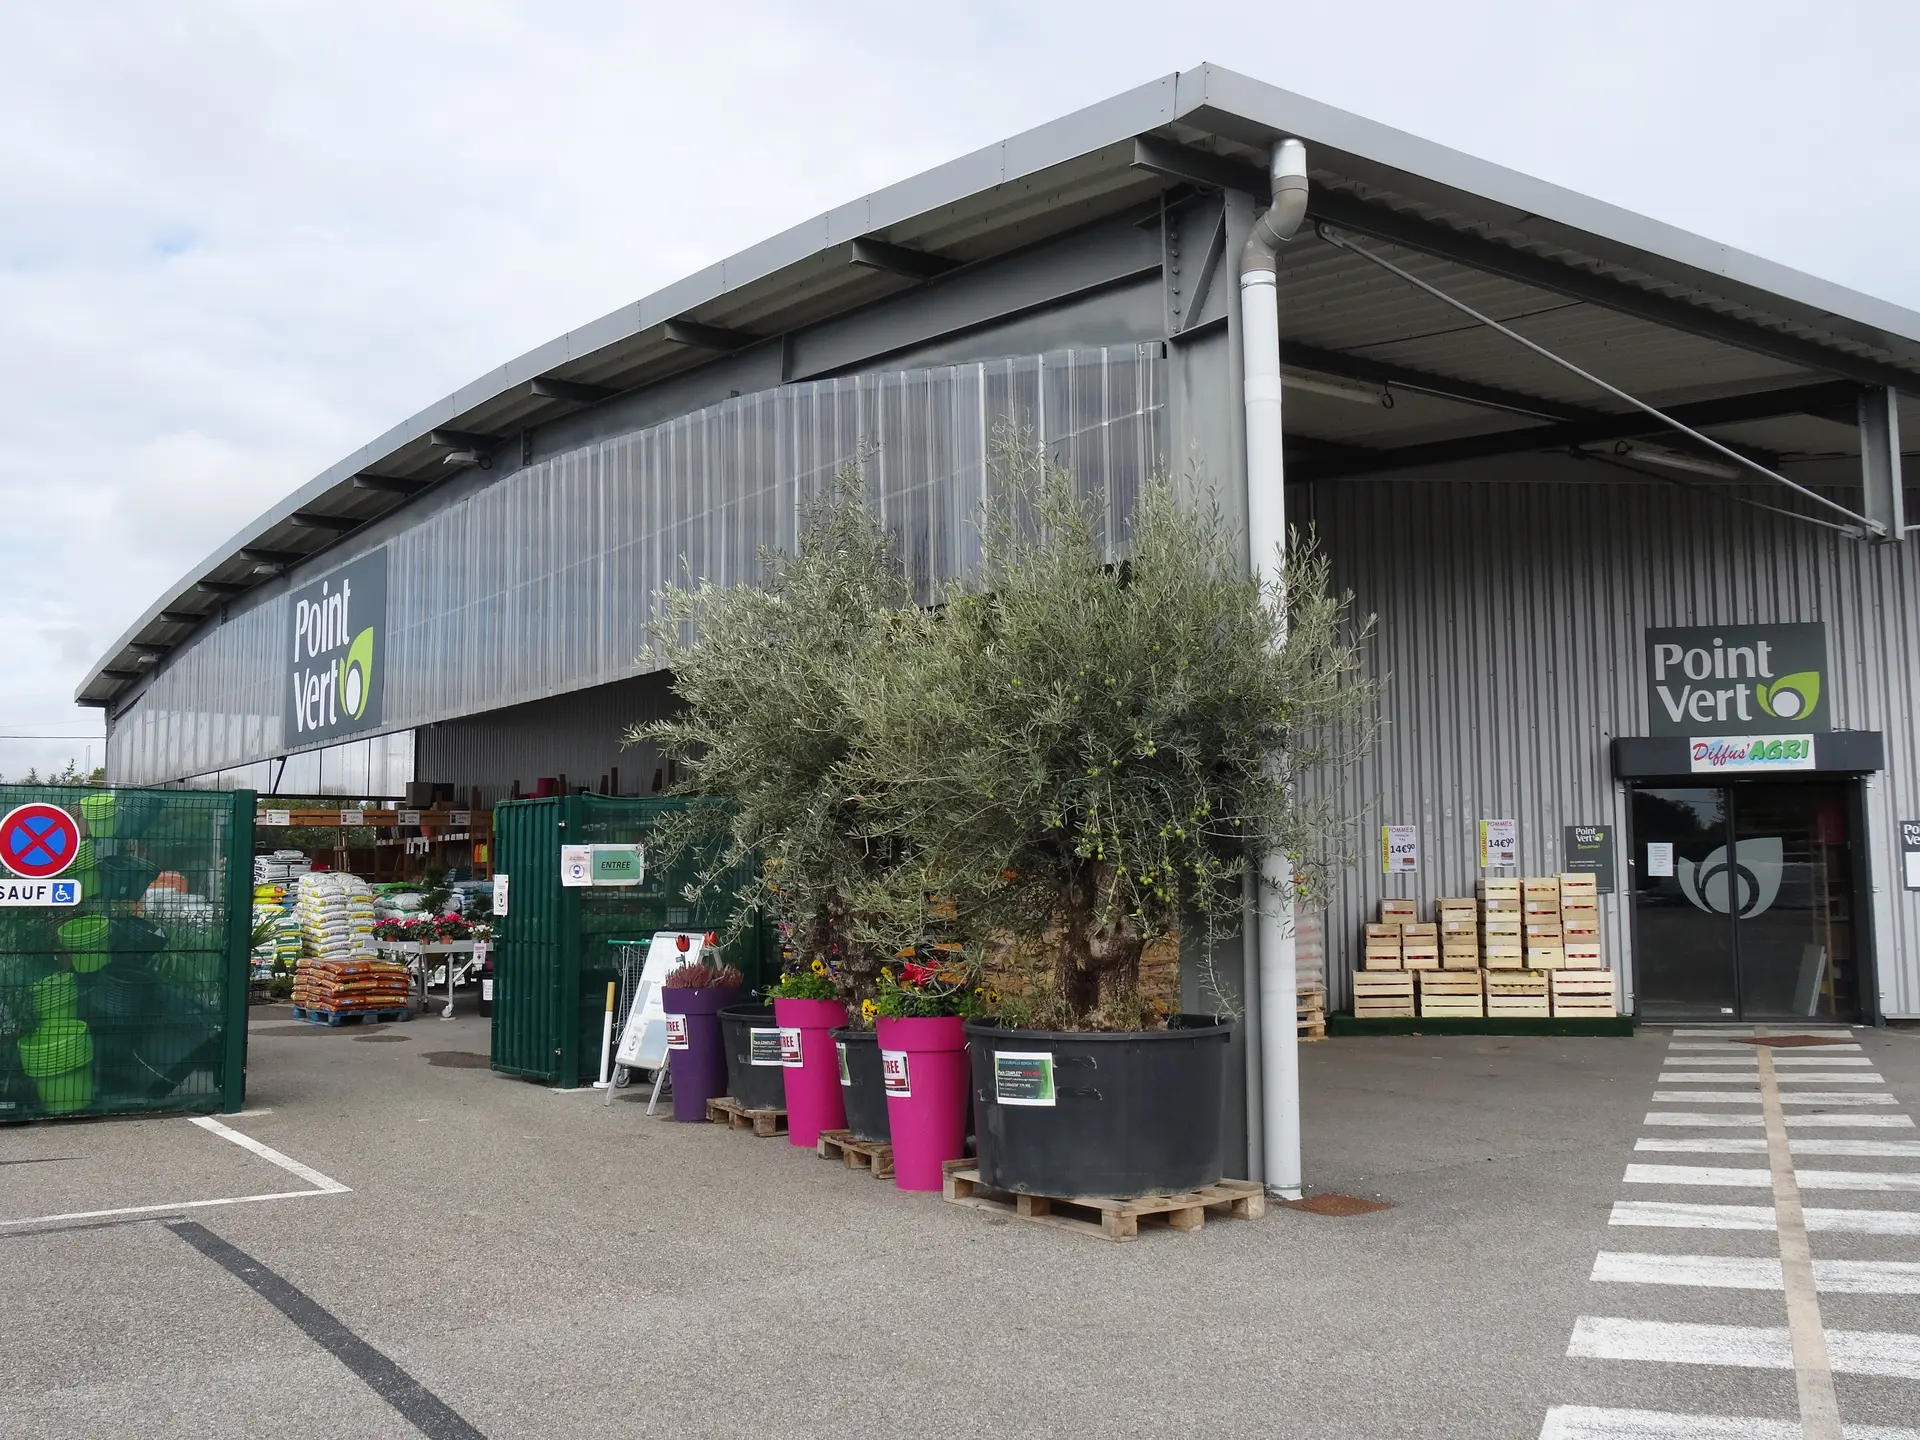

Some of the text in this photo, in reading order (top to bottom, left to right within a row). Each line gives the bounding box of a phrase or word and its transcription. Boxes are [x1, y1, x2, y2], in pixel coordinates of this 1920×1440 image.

[294, 579, 351, 663] Point
[1654, 637, 1774, 680] Point
[294, 659, 338, 732] Vert
[1656, 683, 1753, 723] Vert
[1575, 827, 1596, 835] Point
[1904, 824, 1920, 834] Po
[601, 861, 631, 870] ENTREE
[0, 886, 46, 900] SAUF
